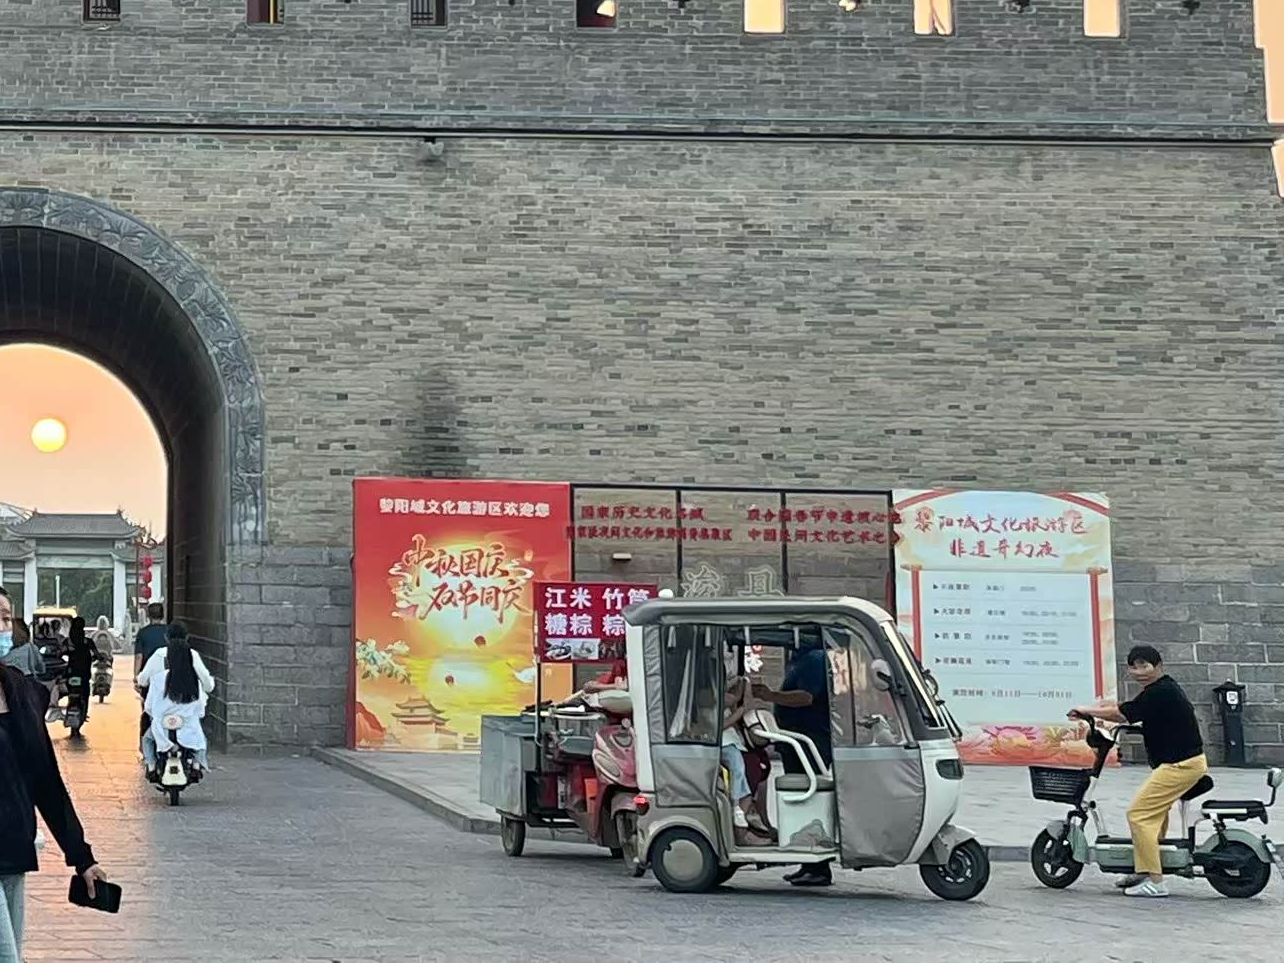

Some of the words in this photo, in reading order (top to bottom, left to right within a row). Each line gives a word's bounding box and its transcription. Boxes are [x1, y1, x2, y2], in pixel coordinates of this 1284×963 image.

[402, 534, 510, 587] 中秋国庆
[544, 587, 592, 609] 江米
[544, 613, 593, 636] 糖粽
